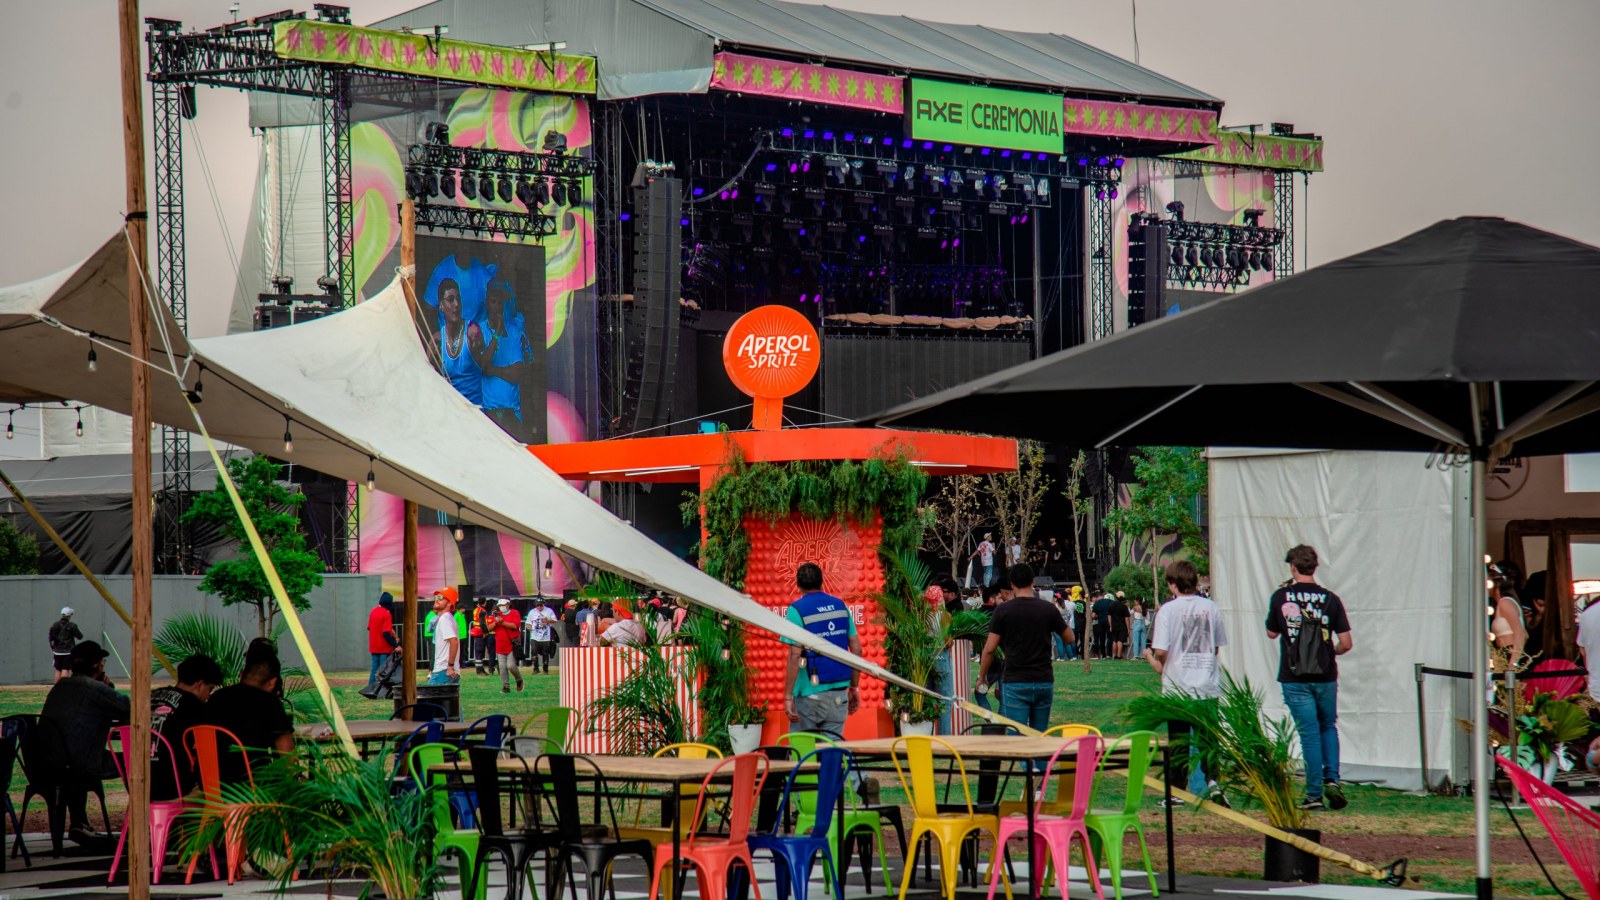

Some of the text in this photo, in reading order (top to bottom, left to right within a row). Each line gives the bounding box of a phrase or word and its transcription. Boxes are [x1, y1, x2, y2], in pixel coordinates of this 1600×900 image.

[916, 99, 1060, 137] AXE CEREMONIA
[737, 334, 811, 357] APEROL
[775, 536, 854, 567] APEROL
[1286, 591, 1327, 603] HAPPY
[817, 605, 836, 613] VALET
